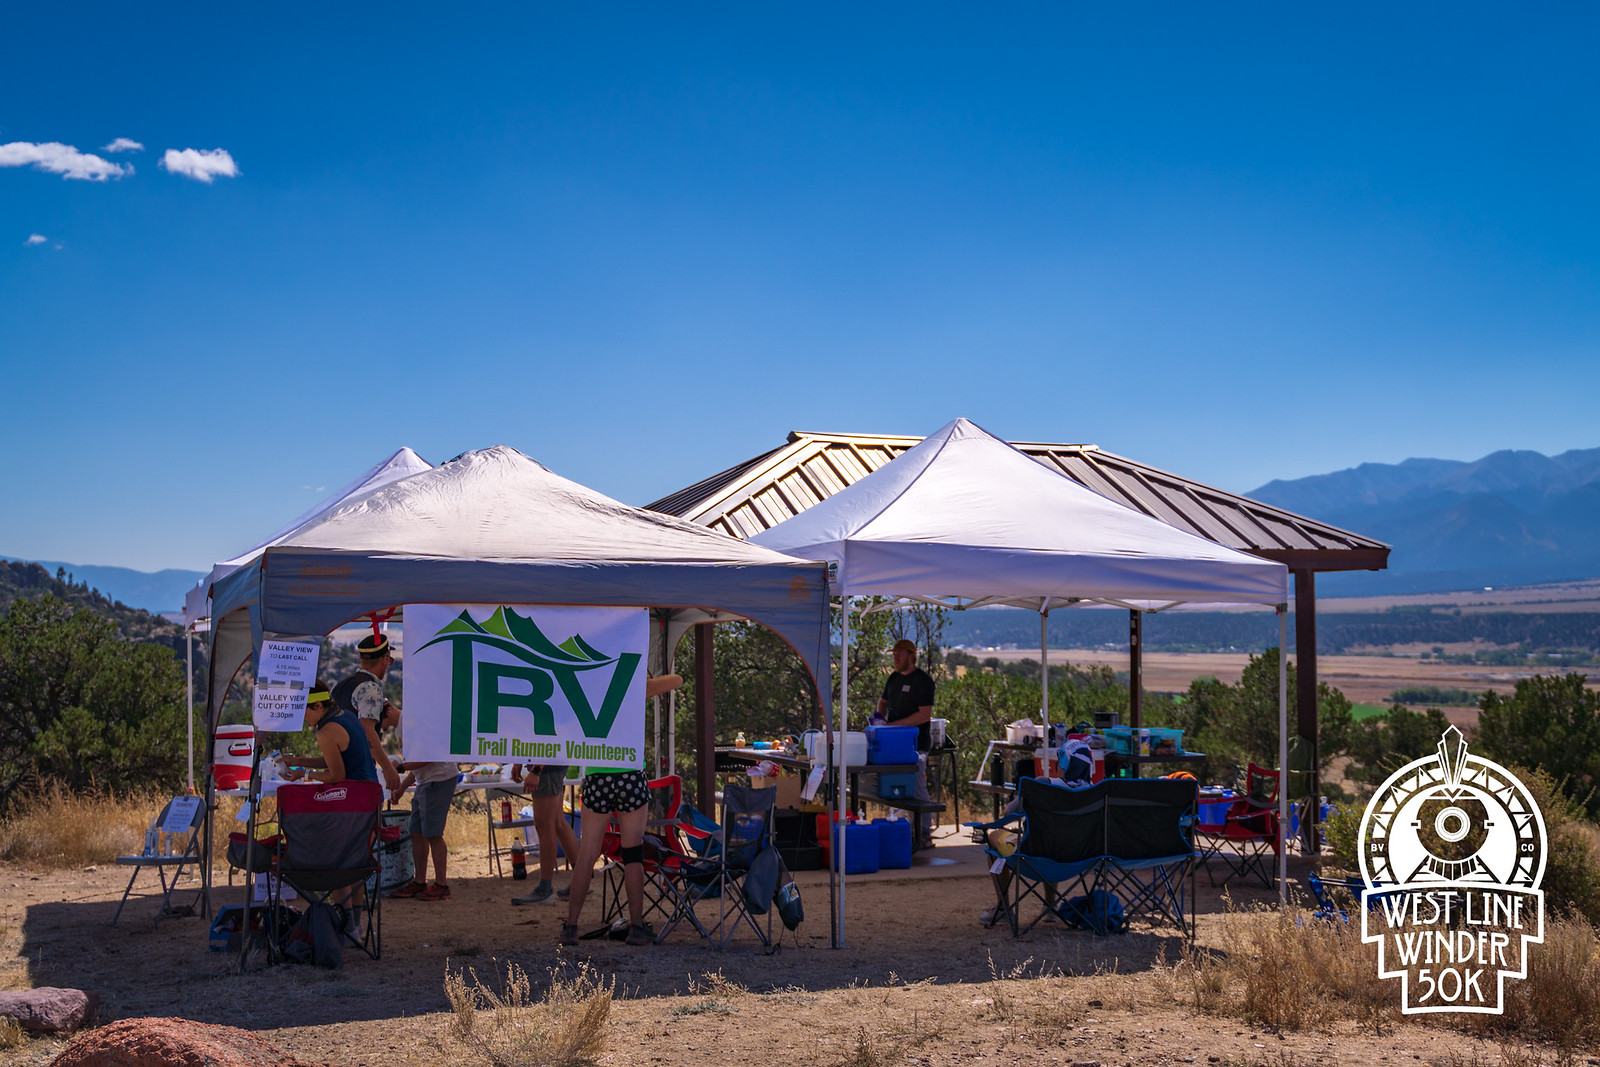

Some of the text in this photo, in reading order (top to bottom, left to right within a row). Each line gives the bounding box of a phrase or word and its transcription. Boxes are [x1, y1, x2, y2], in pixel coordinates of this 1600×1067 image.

[268, 644, 295, 652] VALLEY
[413, 633, 642, 755] TRV
[269, 711, 294, 720] 3:30pm
[476, 737, 637, 762] Trail Runner Volunteers
